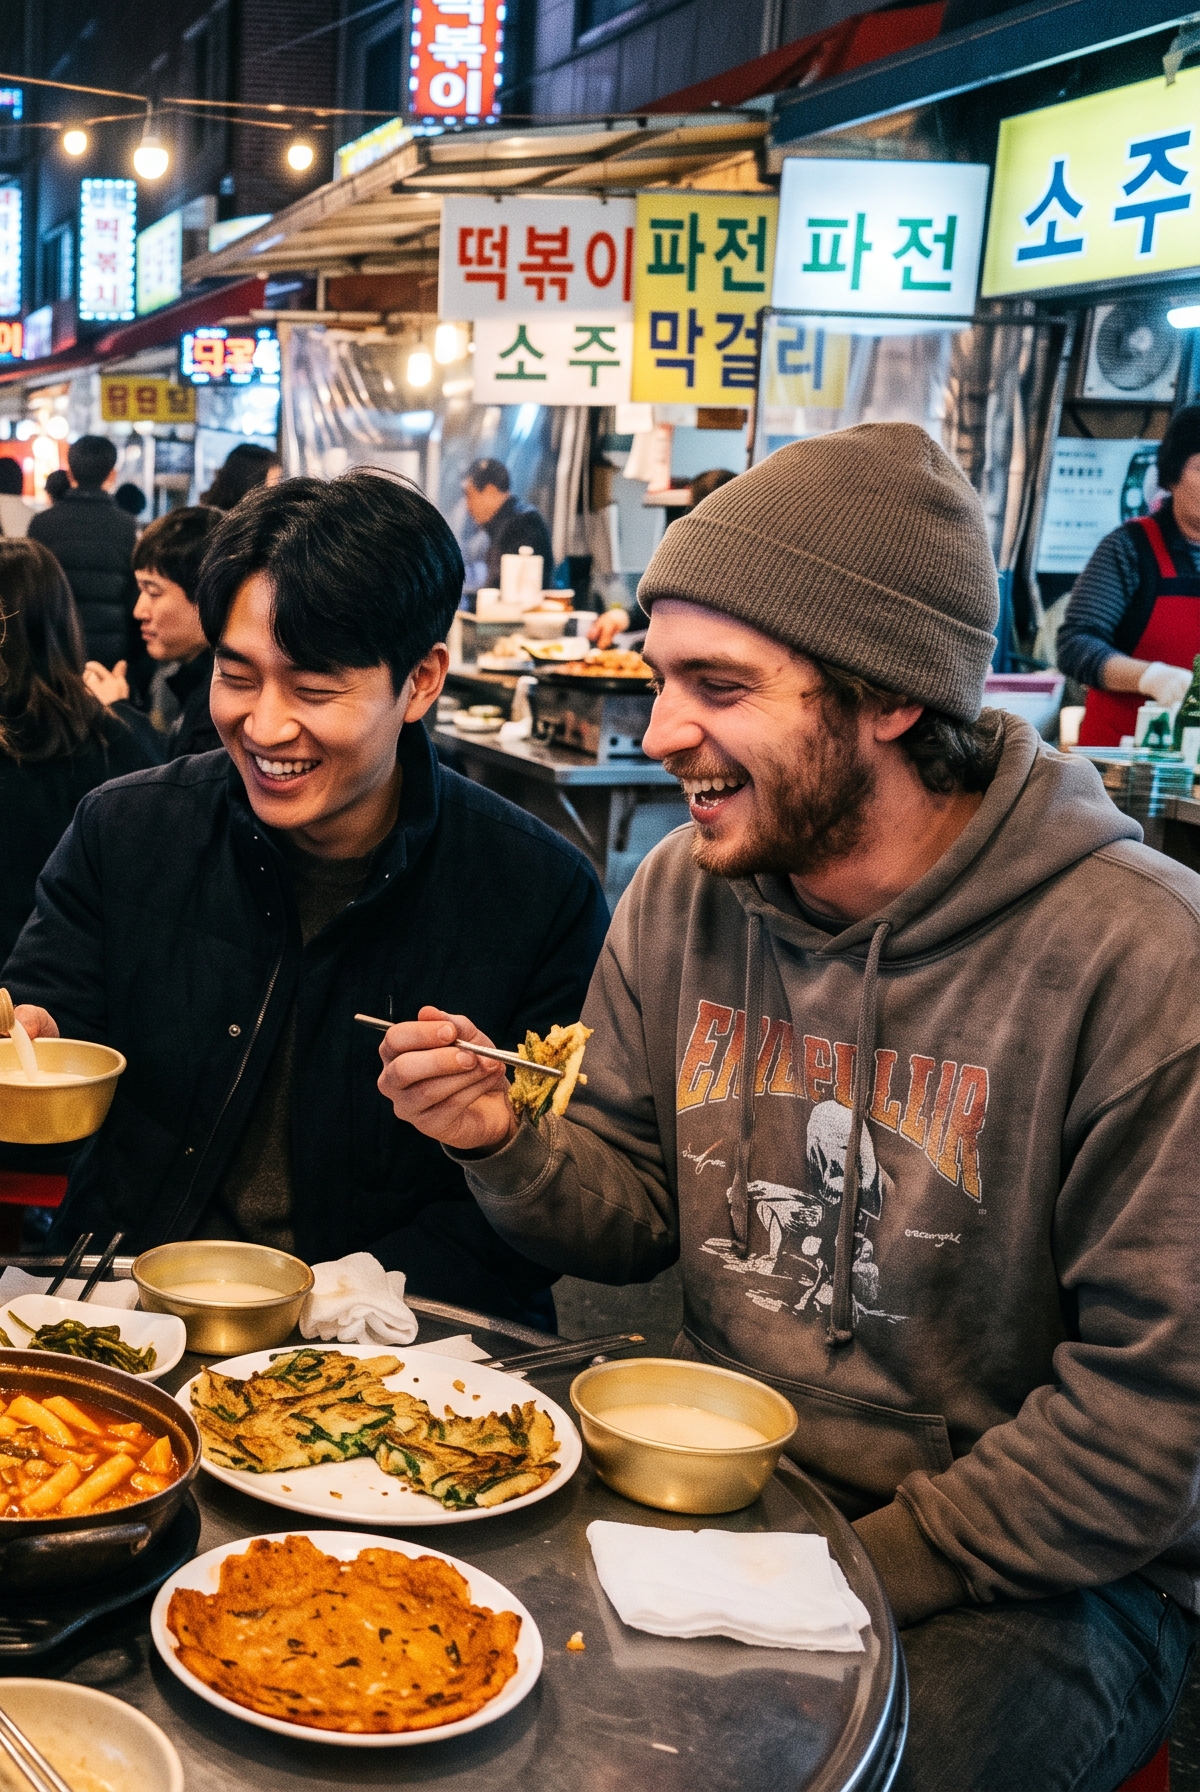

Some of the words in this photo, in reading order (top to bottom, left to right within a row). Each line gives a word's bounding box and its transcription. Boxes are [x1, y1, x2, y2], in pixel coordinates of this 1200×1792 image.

[1016, 129, 1192, 262] 소주
[457, 225, 634, 302] 떡볶이
[646, 212, 768, 293] 파전
[802, 212, 958, 292] 파전
[495, 324, 620, 388] 소주
[649, 308, 826, 391] 막걸리
